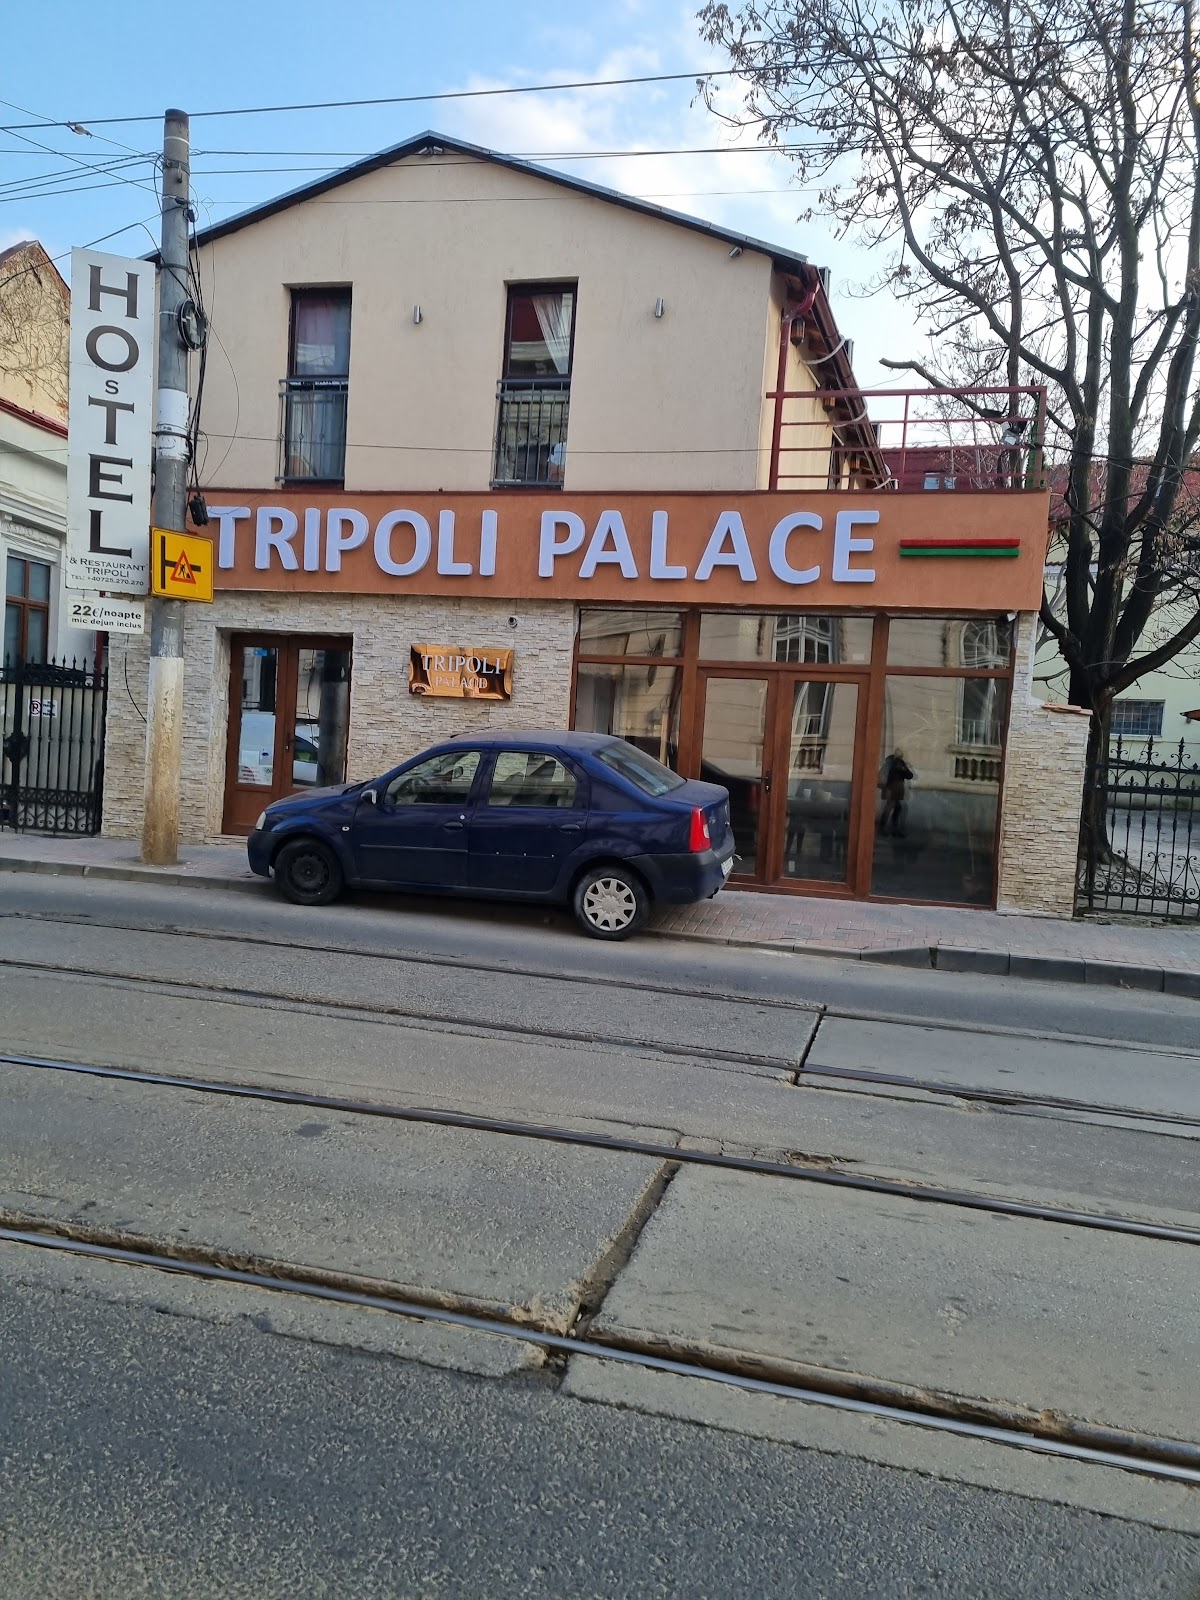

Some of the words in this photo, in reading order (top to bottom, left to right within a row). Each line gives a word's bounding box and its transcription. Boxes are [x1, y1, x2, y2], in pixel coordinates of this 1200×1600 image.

[86, 263, 139, 559] HOSTEL
[206, 505, 497, 576] TRIPOLI
[538, 510, 880, 584] PALACE
[69, 557, 77, 565] &
[85, 566, 129, 578] TRIPOLI
[90, 619, 114, 627] dejun
[116, 620, 142, 629] inclus
[421, 654, 501, 675] TRIPOLI
